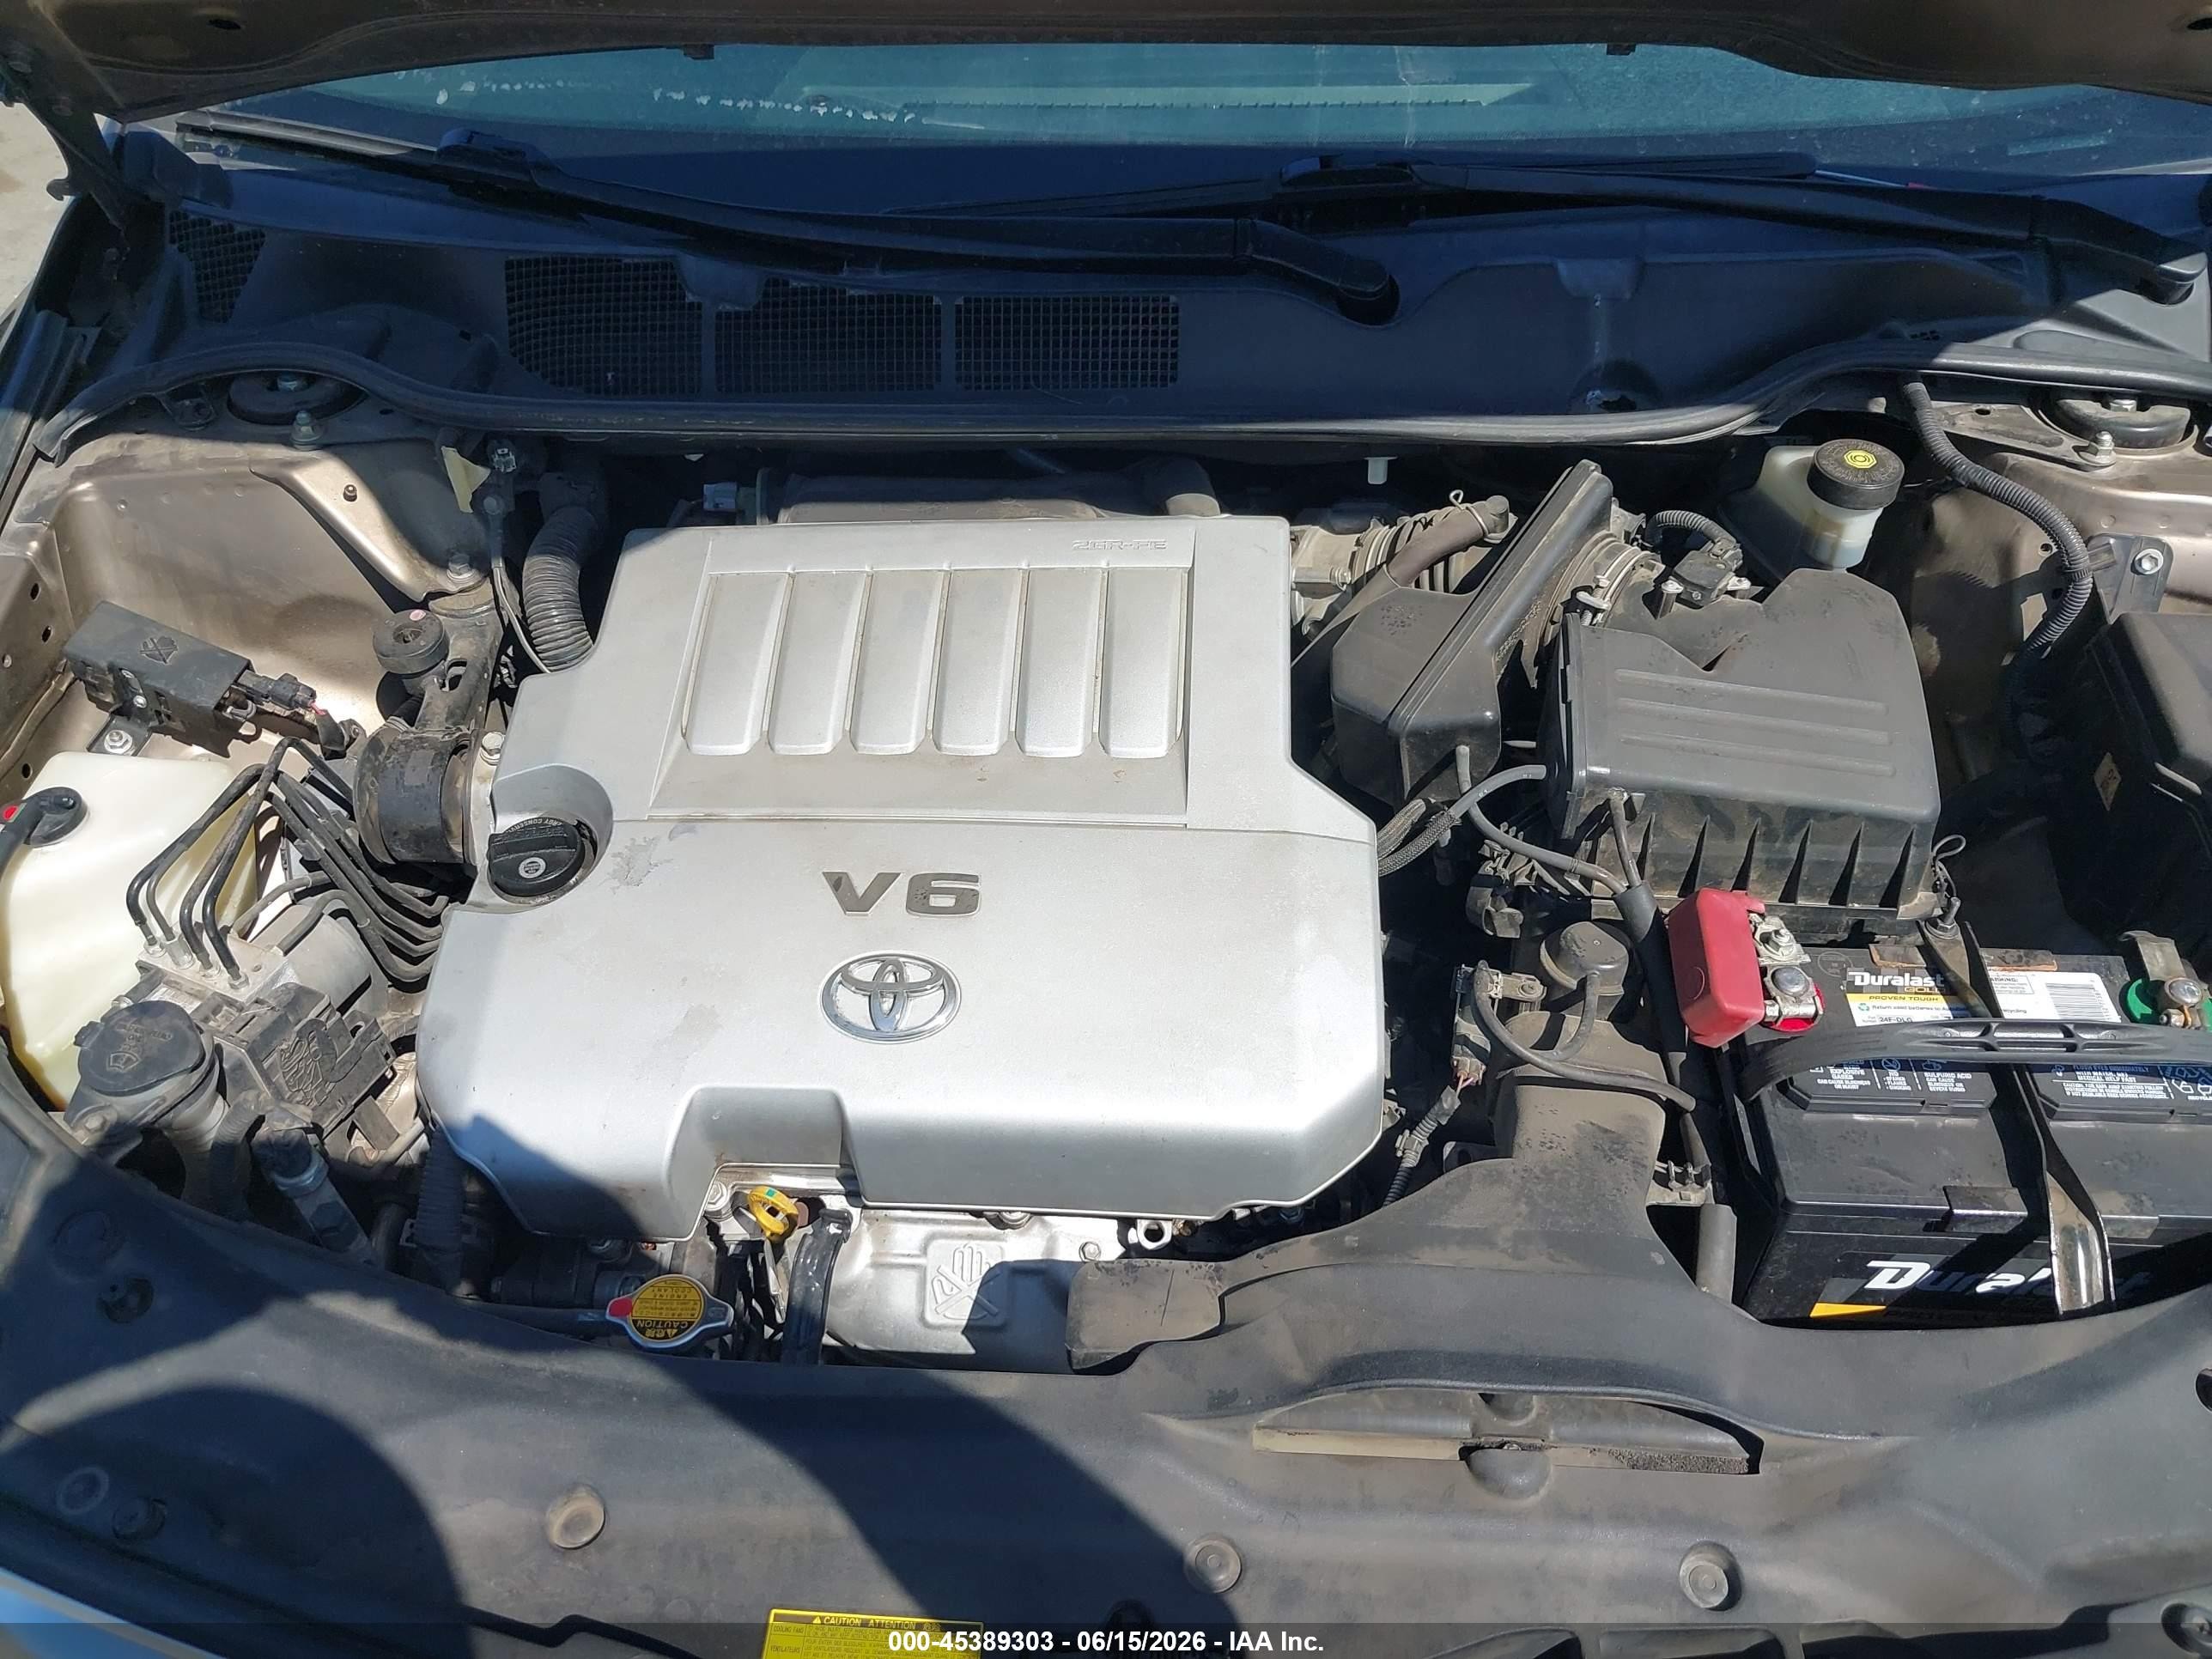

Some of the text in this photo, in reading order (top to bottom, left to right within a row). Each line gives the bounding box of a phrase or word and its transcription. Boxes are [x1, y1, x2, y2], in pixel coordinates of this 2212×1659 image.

[1072, 539, 1168, 550] 2GR-FE
[822, 871, 982, 916] V6
[1848, 971, 1945, 988] Duralast
[636, 1320, 688, 1328] CAUTION
[823, 1616, 862, 1627] CAUTION
[867, 1618, 916, 1631] ATTENTION
